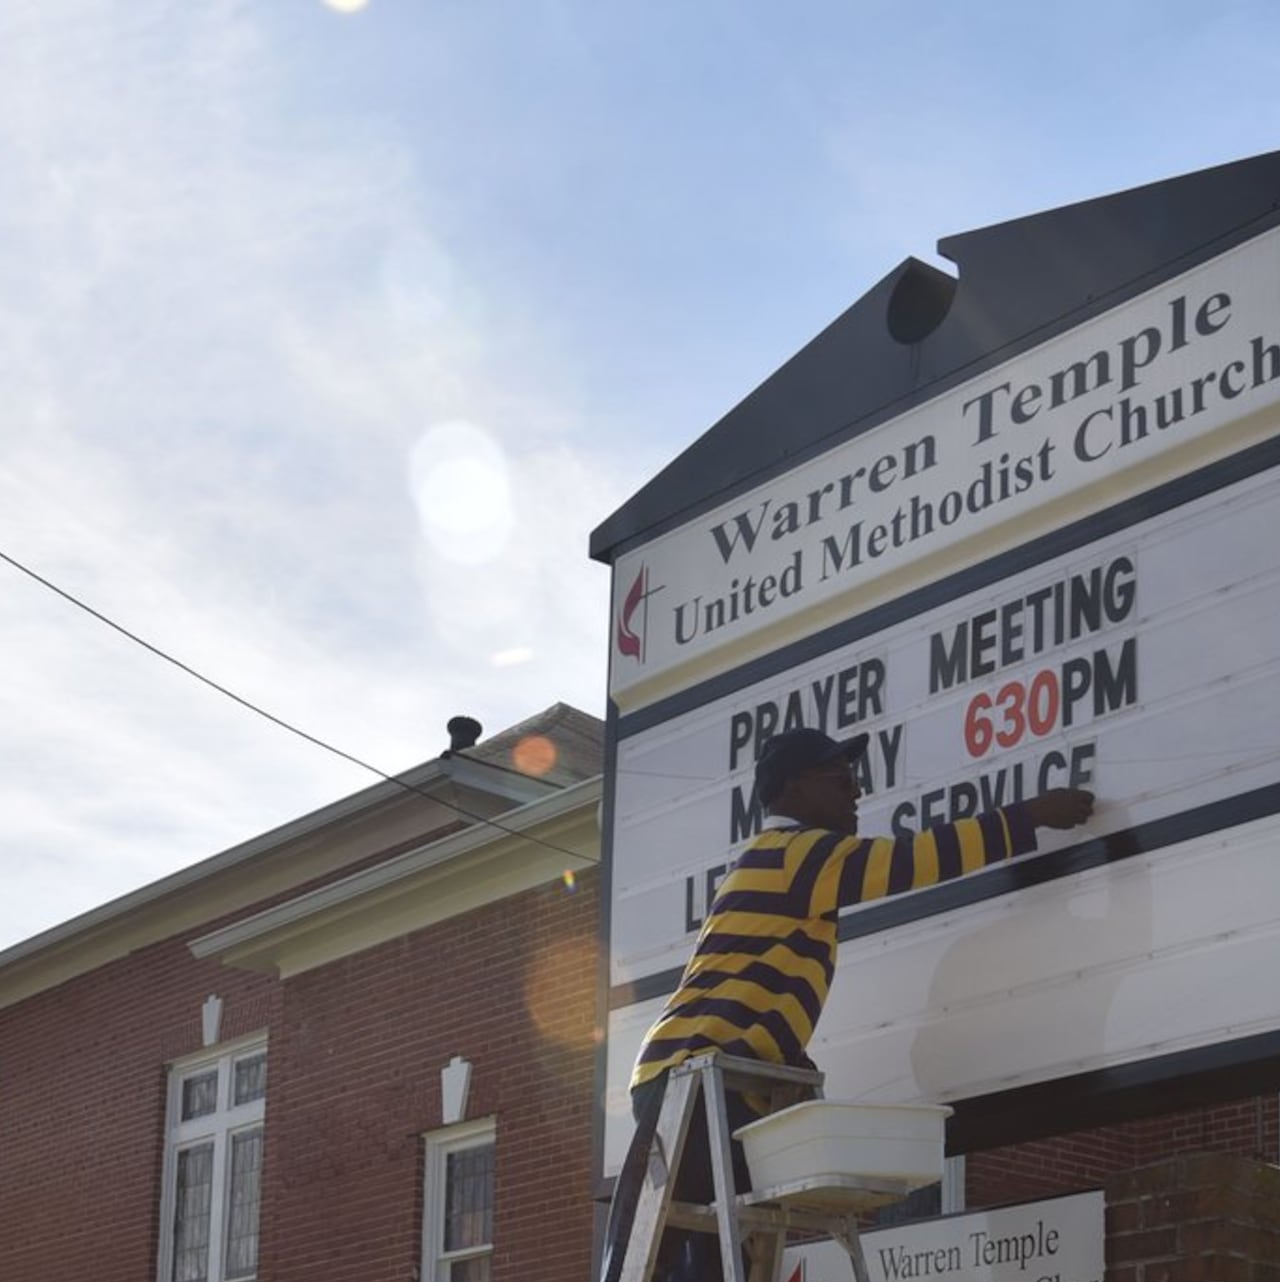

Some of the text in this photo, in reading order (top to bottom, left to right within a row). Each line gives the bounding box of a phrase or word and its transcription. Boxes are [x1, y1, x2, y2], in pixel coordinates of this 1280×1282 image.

[709, 291, 1232, 566] Warren Temple
[672, 550, 803, 646] United
[819, 438, 1056, 582] Methodist
[729, 556, 1137, 771] PRAYER MEETING
[964, 638, 1138, 758] 630PM
[879, 1220, 1060, 1282] Warren Temple
